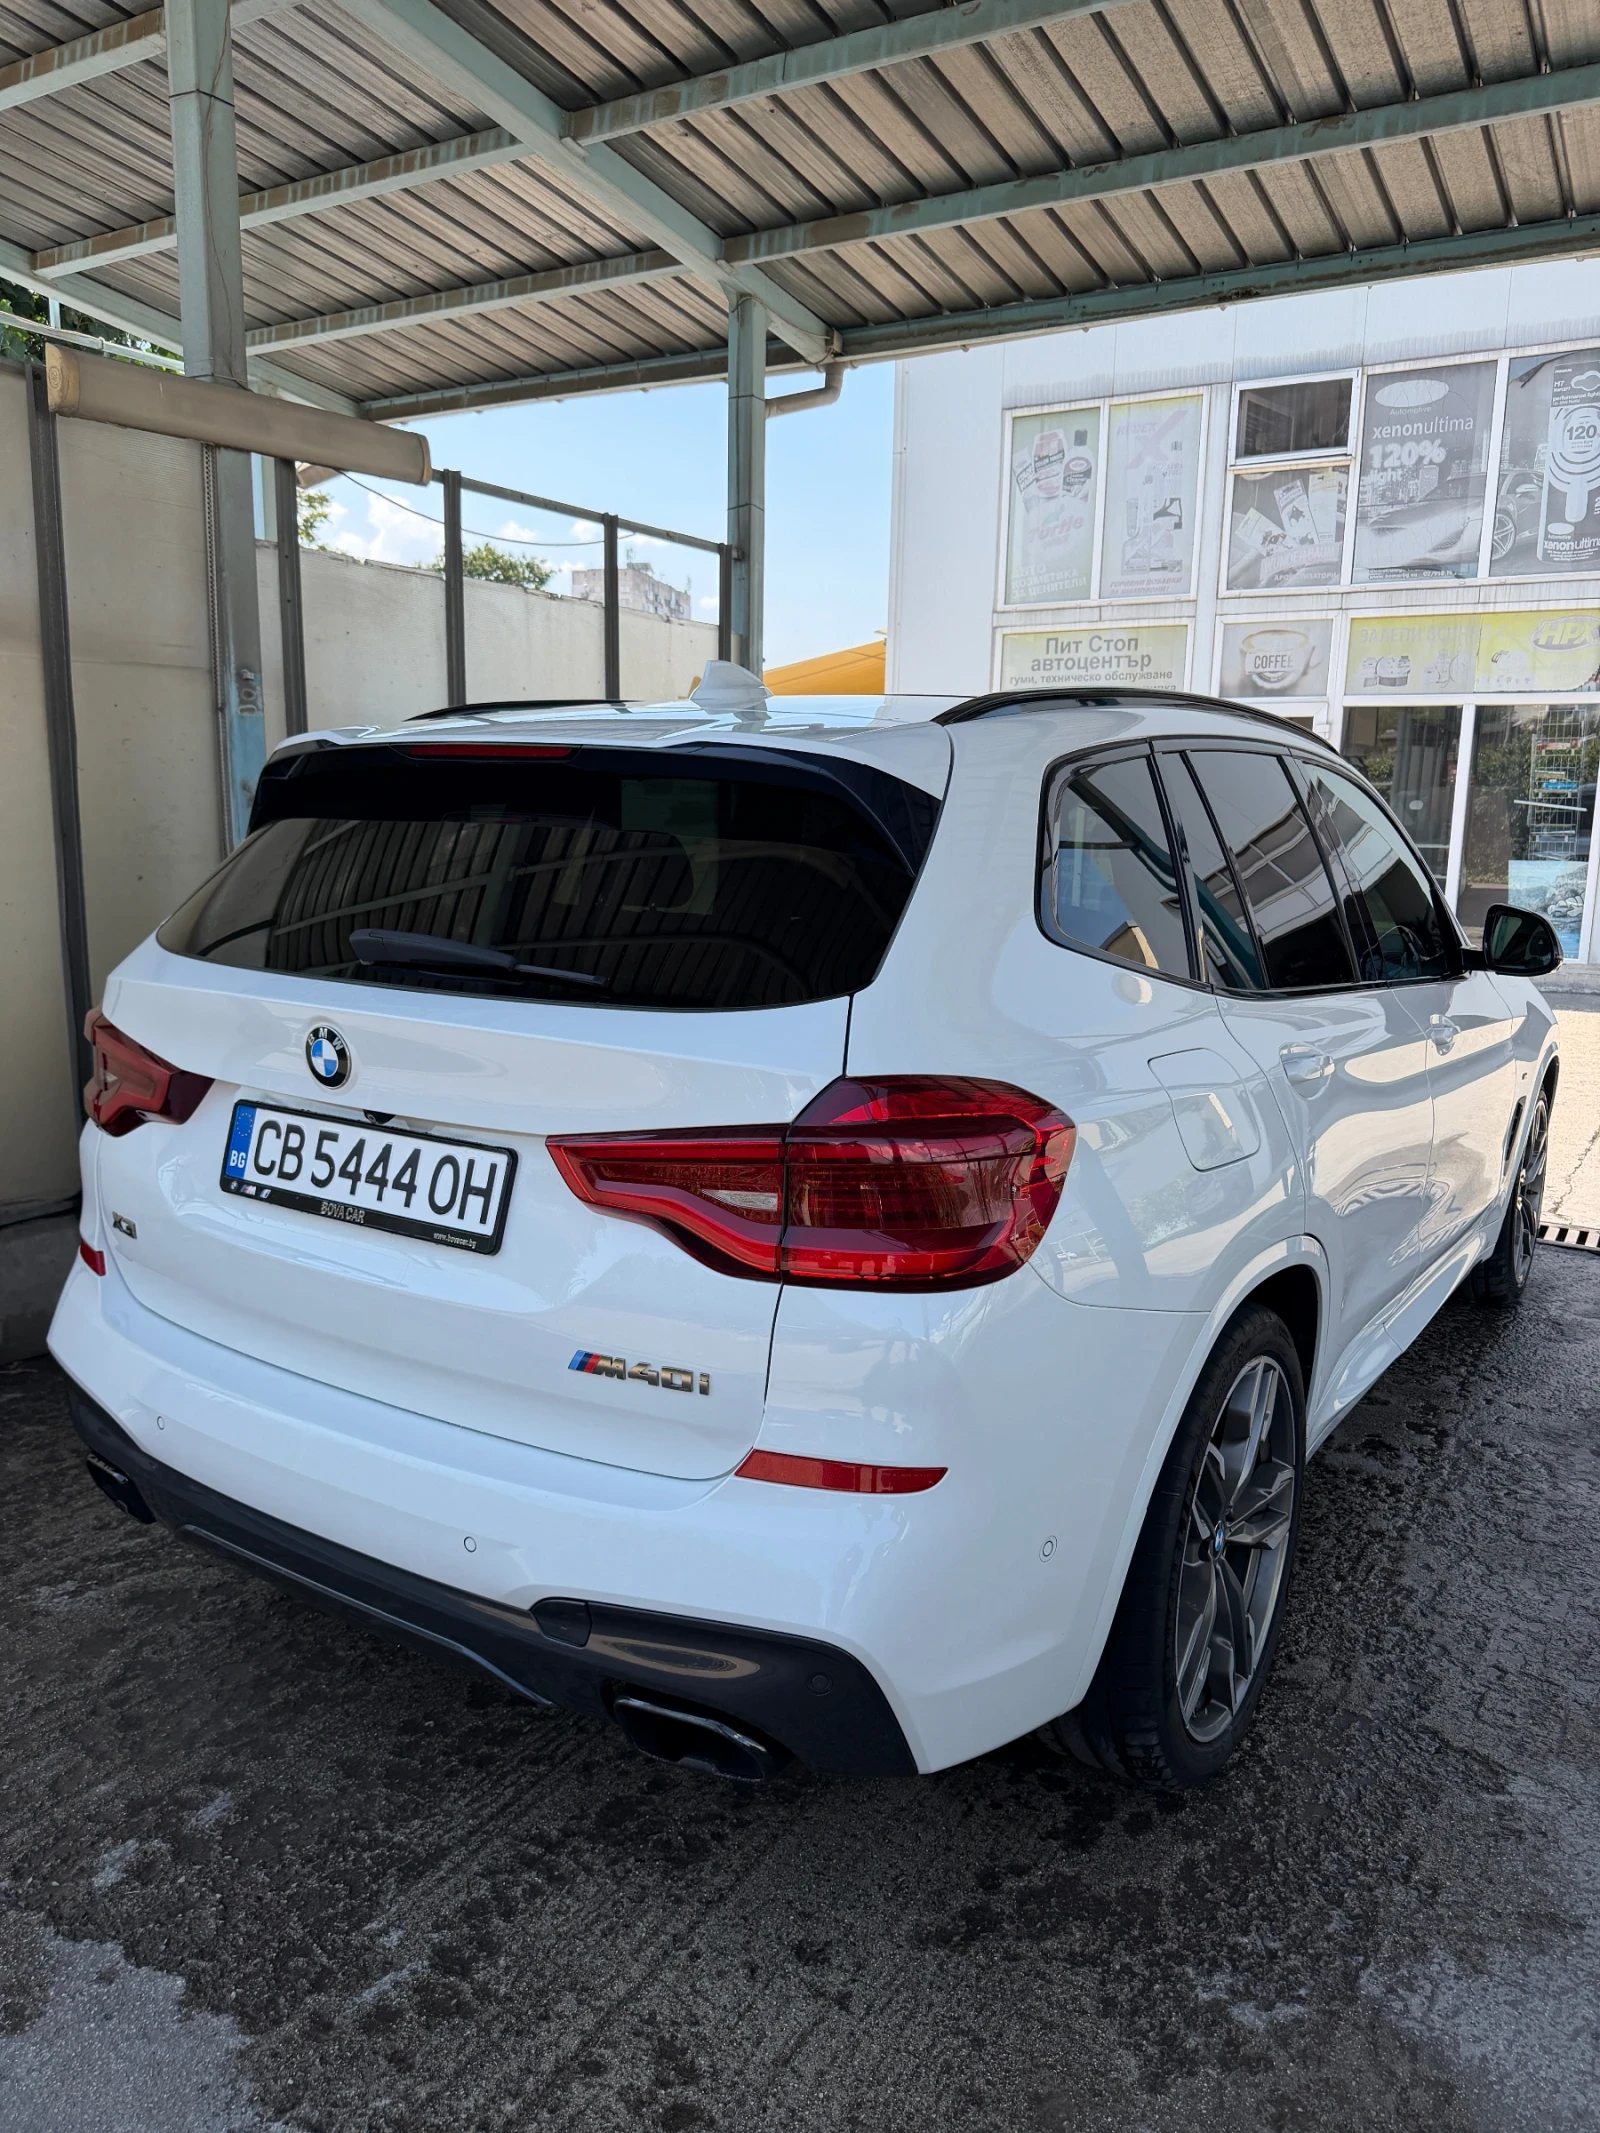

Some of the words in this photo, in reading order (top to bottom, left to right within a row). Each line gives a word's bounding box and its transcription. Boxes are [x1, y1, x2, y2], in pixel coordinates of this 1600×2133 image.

[1389, 405, 1432, 416] Automotive
[1372, 416, 1474, 440] xenonultima
[1369, 438, 1447, 469] 120%
[1045, 637, 1083, 655] Пит
[1088, 635, 1139, 652] Стоп
[1538, 622, 1599, 645] HPX
[1031, 653, 1152, 672] автоцентър
[1254, 654, 1293, 669] COFFEE
[1010, 676, 1038, 685] гуми,
[1040, 674, 1101, 684] техническо
[1104, 671, 1173, 683] обслужване
[308, 1027, 344, 1051] BMW
[229, 1149, 247, 1169] BG
[253, 1119, 306, 1182] CB
[310, 1129, 422, 1209] 5444
[427, 1154, 498, 1225] OH
[320, 1201, 345, 1220] BOVA
[345, 1206, 366, 1225] CAR
[112, 1211, 137, 1240] X3
[592, 1353, 710, 1396] M40i
